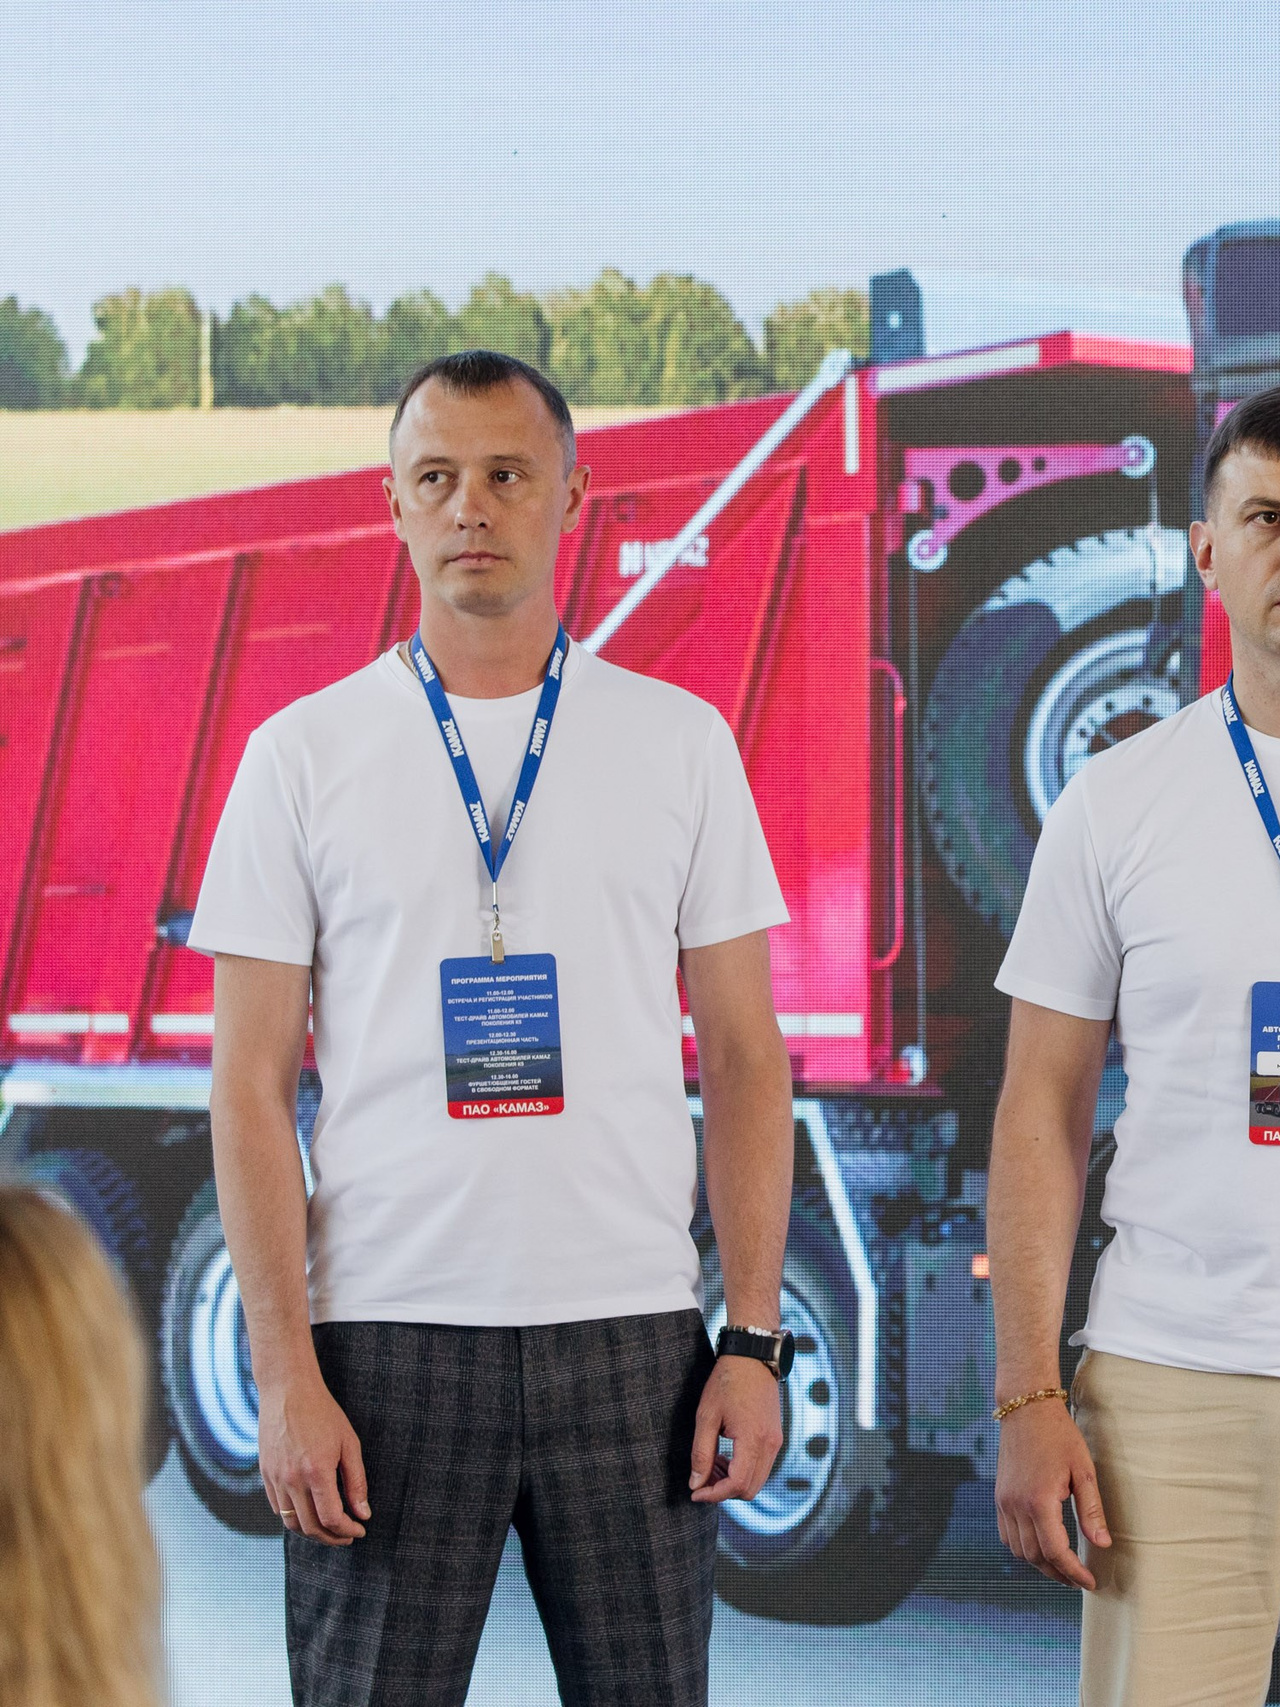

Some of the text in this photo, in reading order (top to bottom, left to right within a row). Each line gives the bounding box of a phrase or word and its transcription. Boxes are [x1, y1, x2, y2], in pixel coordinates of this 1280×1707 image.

[415, 648, 435, 684] KAMAZ
[549, 647, 564, 681] KAMAZ
[441, 718, 465, 758] KAMAZ
[529, 717, 549, 758] KAMAZ
[1244, 759, 1265, 798] KAMAZ
[469, 800, 490, 844] KAMAZ
[505, 800, 526, 842] KAMAZ
[451, 974, 547, 985] ПРОГРАММА МЕРОПРИЯТИЯ
[463, 1101, 550, 1116] ПАО «КАМАЗ»
